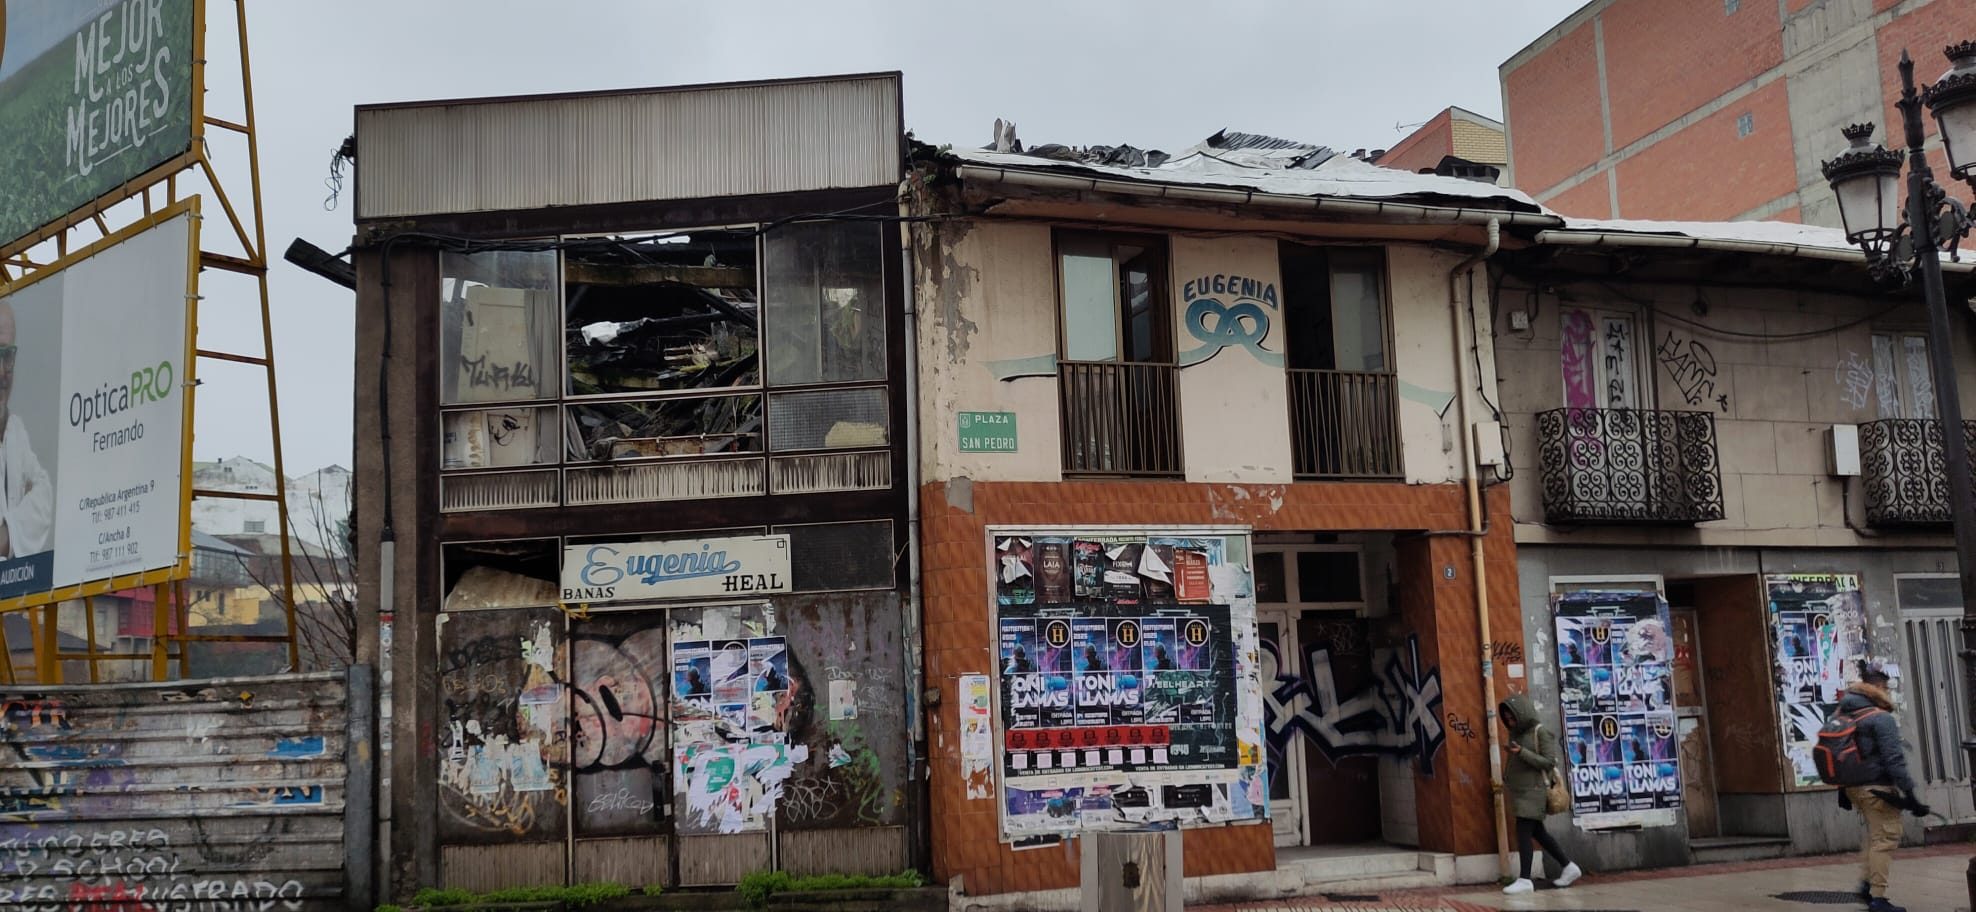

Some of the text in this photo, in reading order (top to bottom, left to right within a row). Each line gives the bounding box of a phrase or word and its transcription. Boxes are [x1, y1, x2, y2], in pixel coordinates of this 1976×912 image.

[75, 0, 163, 102] MEJOR
[106, 63, 133, 96] A LOS
[66, 46, 170, 176] MEJORES
[1183, 274, 1278, 312] EUGENIA
[975, 414, 1008, 424] PLAZA
[93, 418, 144, 453] Fernando
[962, 437, 1015, 449] SAN PEDRO
[117, 483, 148, 502] Argentina
[150, 479, 154, 492] 9
[104, 506, 116, 521] 987
[117, 503, 127, 517] 411
[127, 541, 138, 555] 902
[581, 543, 741, 586] Eugenia
[563, 573, 784, 600] BANAS HEAL
[1052, 628, 1064, 643] H
[1122, 628, 1134, 642] H
[1190, 628, 1203, 641] H
[1014, 674, 1045, 692] ONI
[1075, 673, 1116, 691] TONI
[1079, 689, 1139, 707] LLAMAS
[1572, 764, 1604, 782] TONI
[1626, 762, 1657, 779] TONI
[1575, 779, 1623, 797] LLAMAS
[1629, 777, 1677, 794] LLAMAS
